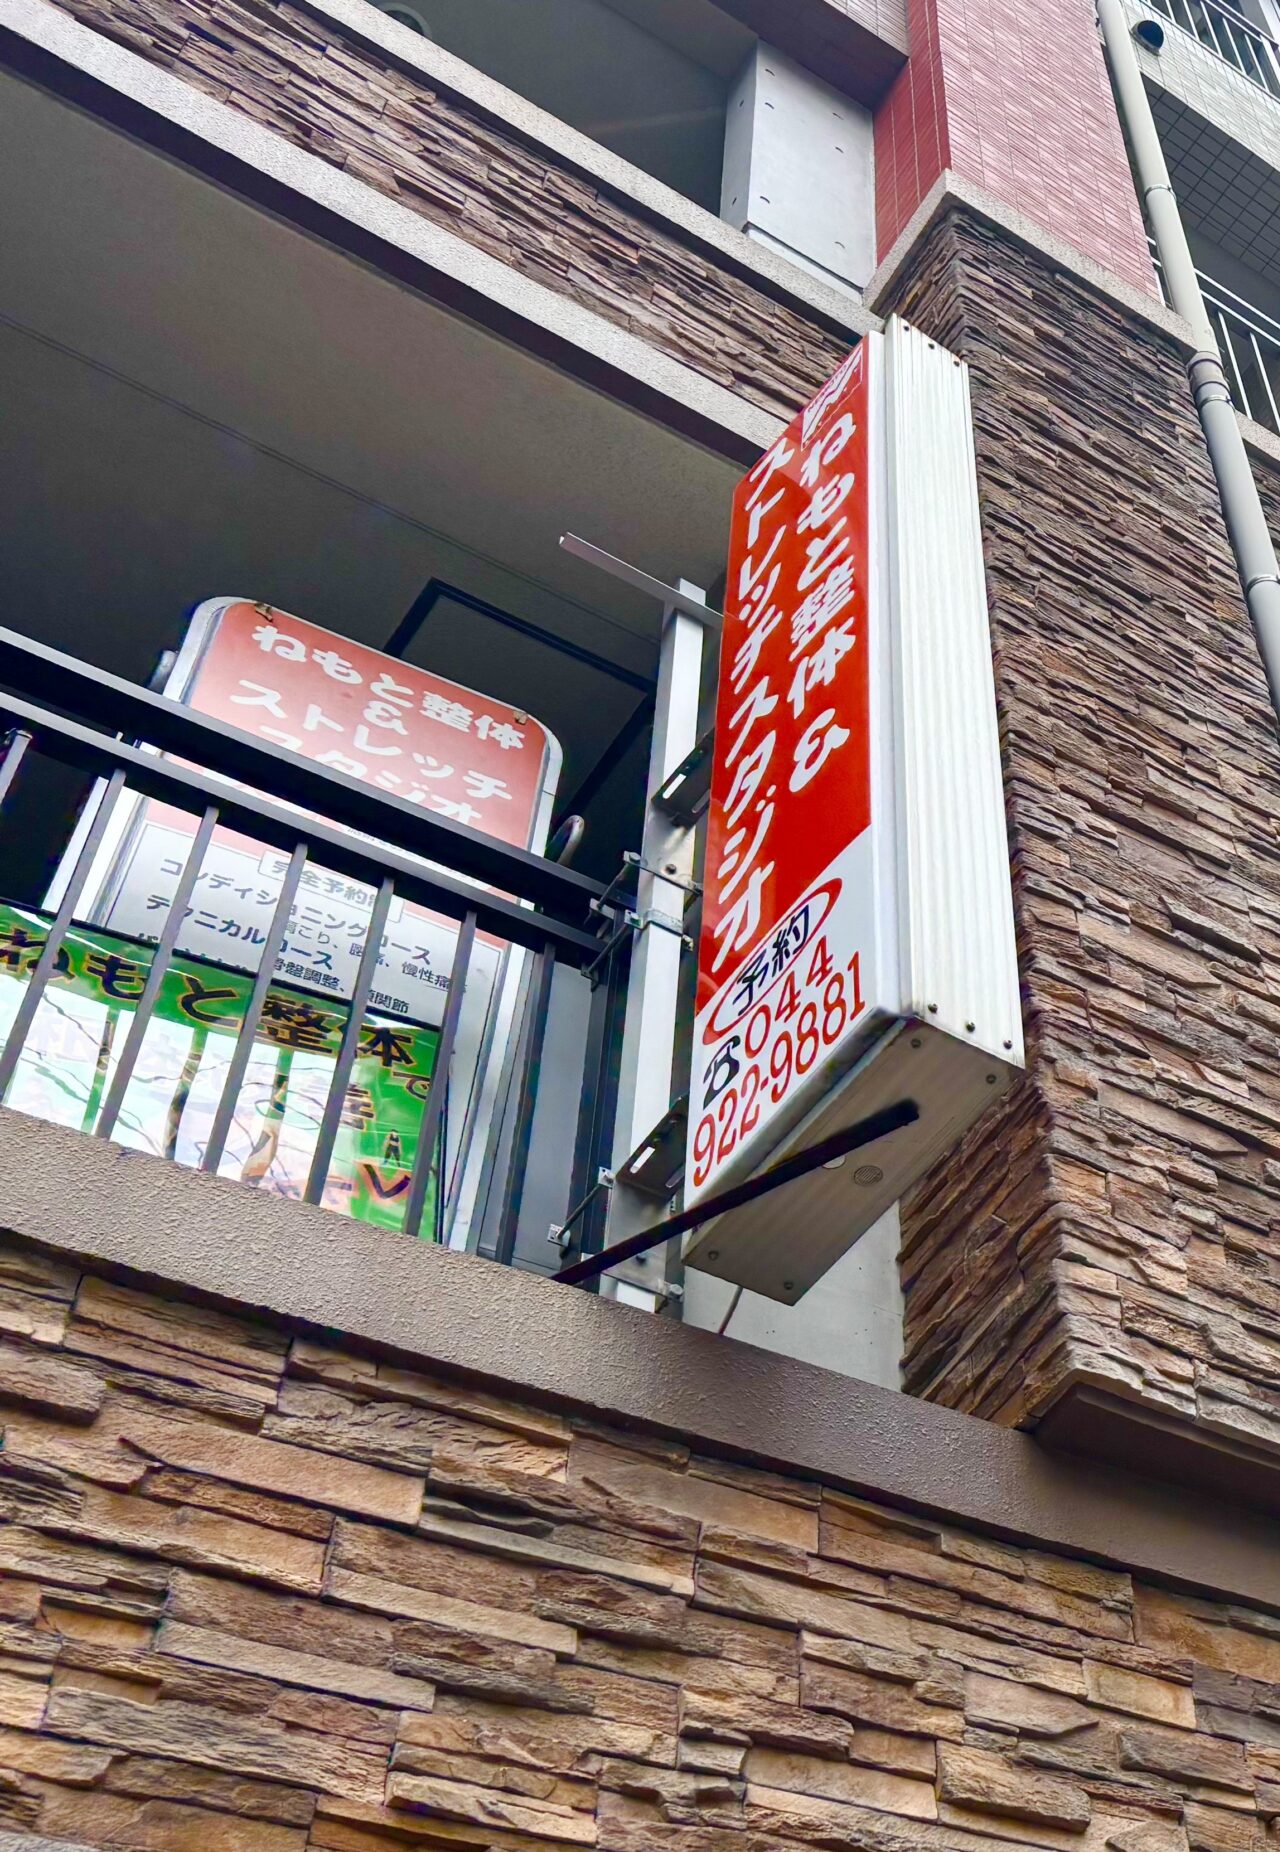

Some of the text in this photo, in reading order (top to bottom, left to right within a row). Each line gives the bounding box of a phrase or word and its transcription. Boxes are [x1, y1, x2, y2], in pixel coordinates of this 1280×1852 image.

[229, 679, 513, 800] ストレッチ
[251, 624, 526, 749] ねもと整体
[362, 699, 409, 736] &
[711, 437, 795, 974] ストレッチスタジオ
[732, 903, 811, 1017] 予約
[743, 934, 834, 1060] 044
[693, 950, 867, 1188] 922-9881
